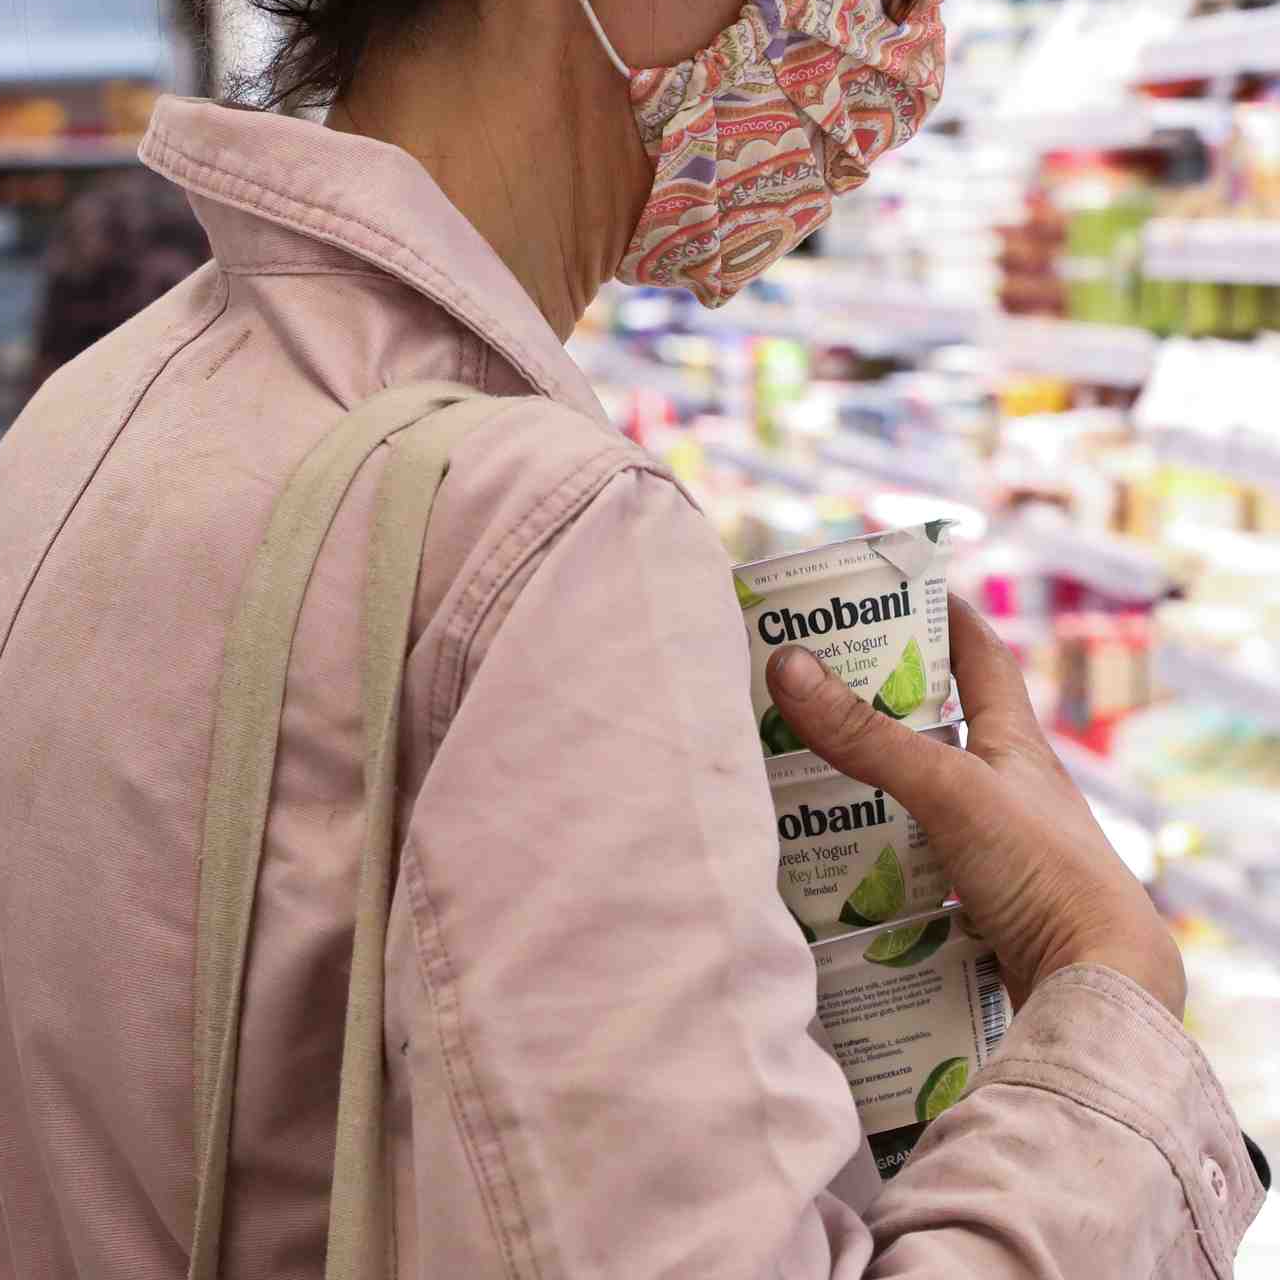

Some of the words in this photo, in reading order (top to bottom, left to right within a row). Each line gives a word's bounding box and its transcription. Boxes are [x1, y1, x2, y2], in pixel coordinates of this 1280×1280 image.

[758, 581, 911, 645] Chobani
[816, 642, 841, 659] eek
[843, 634, 888, 654] Yogurt
[846, 656, 879, 673] Lime
[847, 676, 869, 689] nded
[778, 789, 887, 840] obani
[812, 841, 859, 861] Yogurt
[788, 869, 812, 884] Key
[815, 863, 848, 880] Lime
[803, 882, 839, 897] Blended
